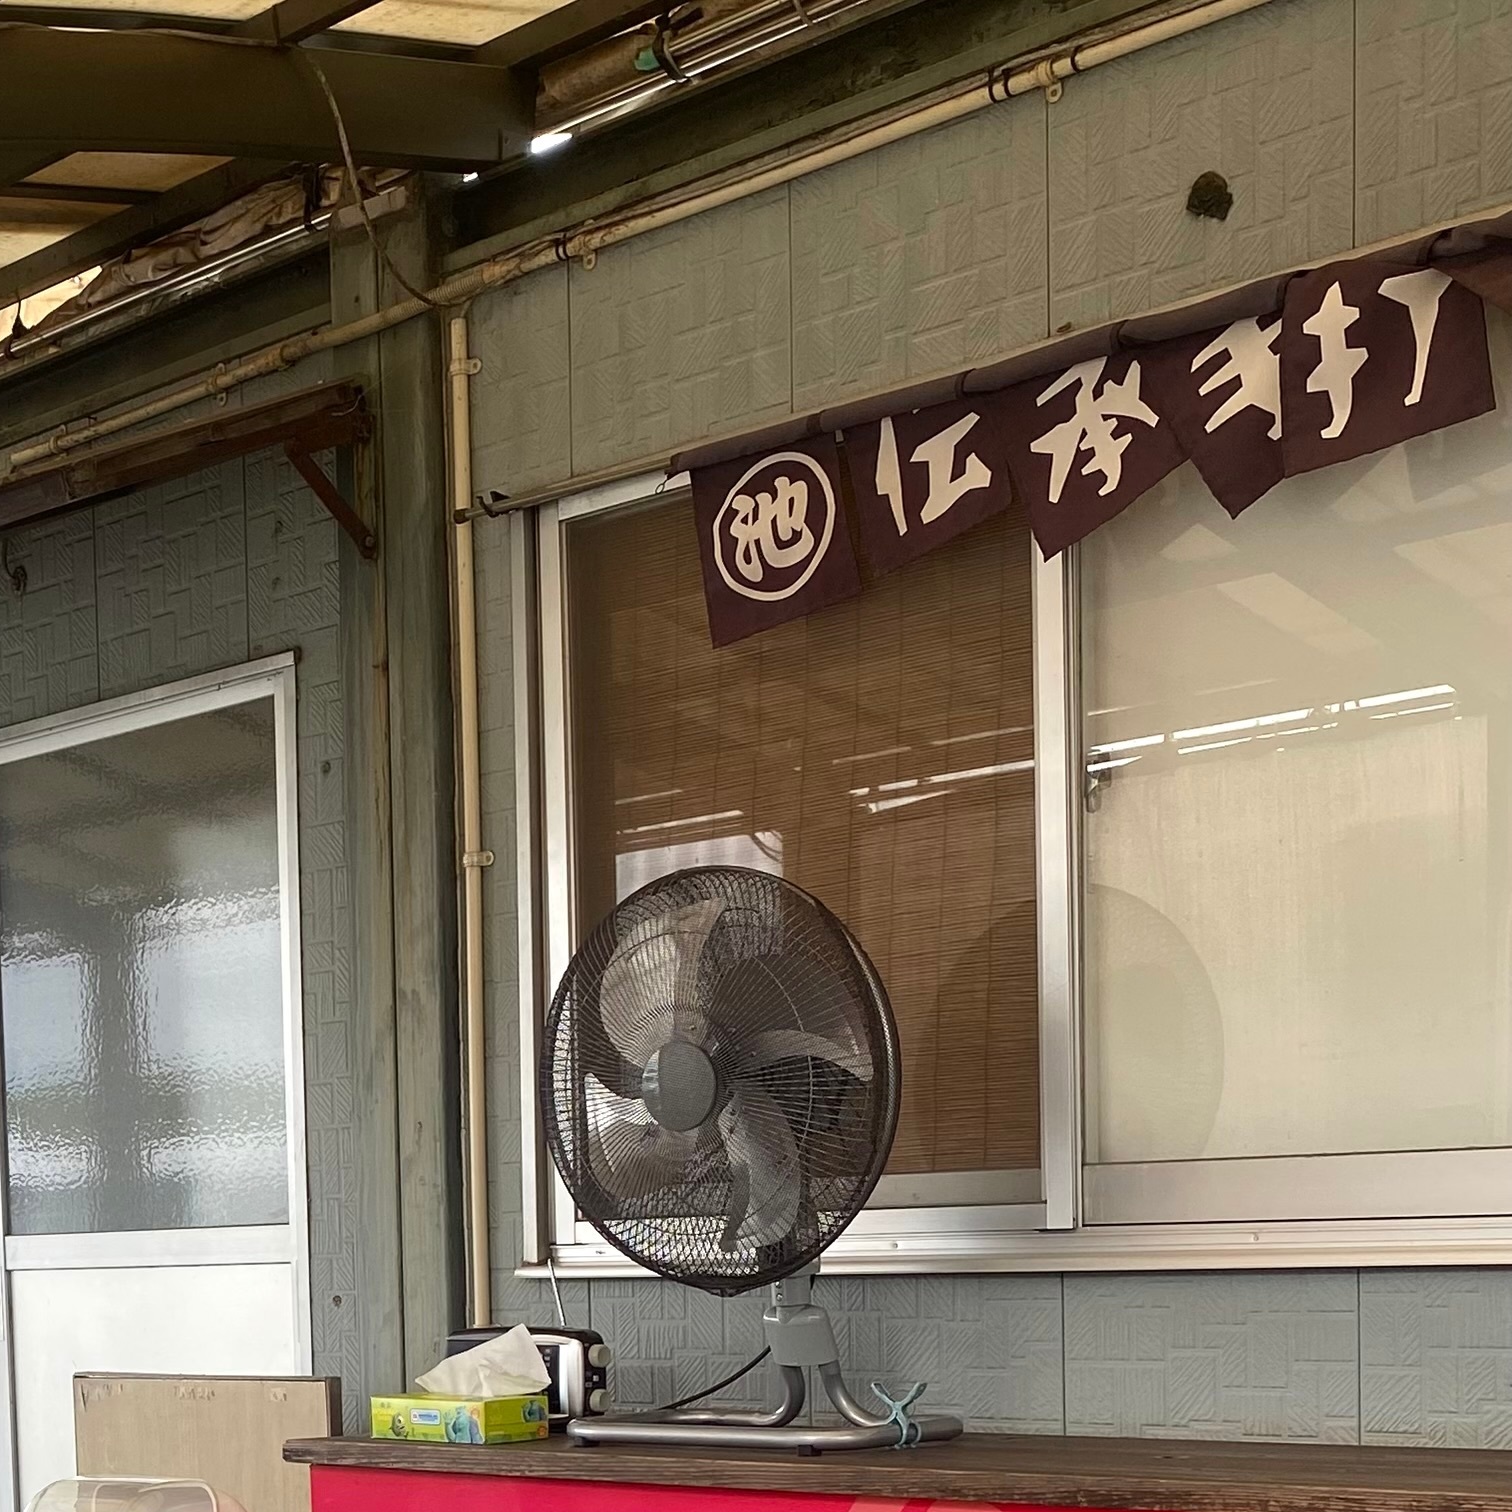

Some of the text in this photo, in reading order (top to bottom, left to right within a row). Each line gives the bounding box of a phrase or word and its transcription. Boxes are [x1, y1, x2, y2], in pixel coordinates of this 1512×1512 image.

[725, 268, 1453, 587] 池 伝承手打
